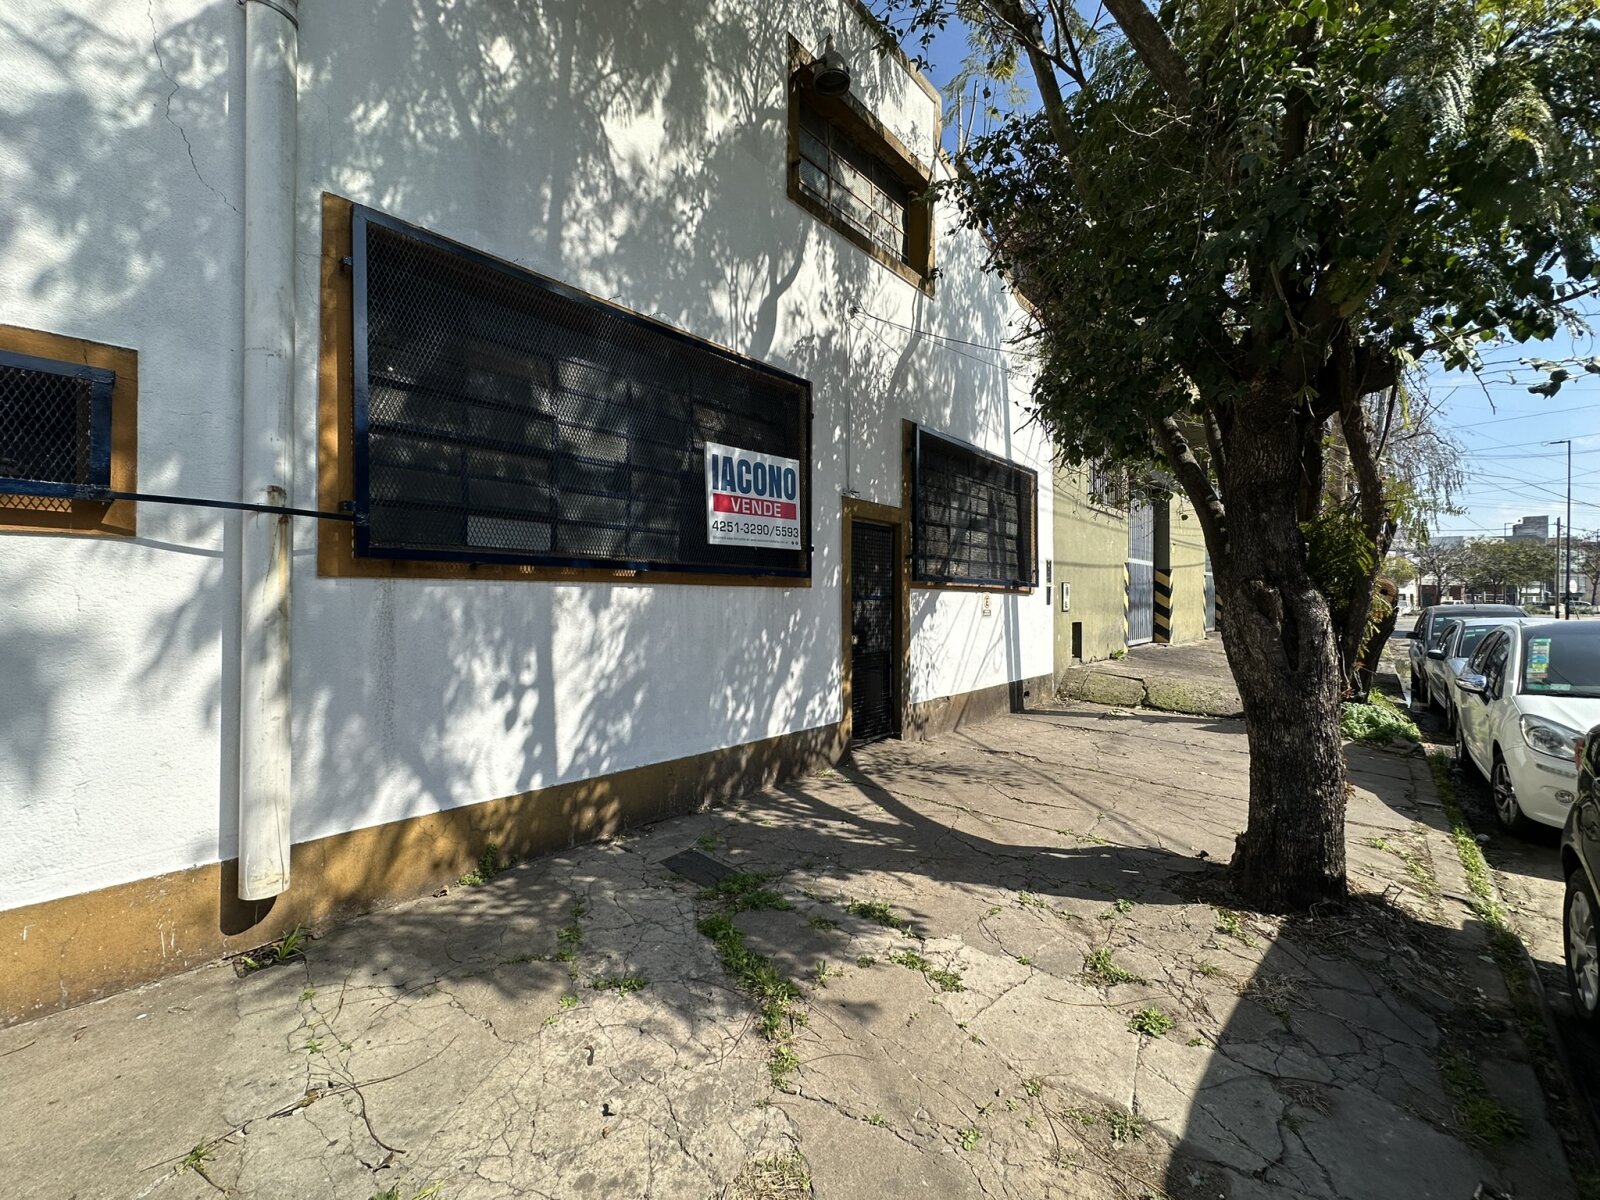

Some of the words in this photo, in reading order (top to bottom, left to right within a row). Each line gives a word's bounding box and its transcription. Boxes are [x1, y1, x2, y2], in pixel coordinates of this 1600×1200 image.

[712, 454, 796, 500] IACONO
[731, 497, 782, 516] VENDE
[712, 520, 799, 538] 4251-3290/5593
